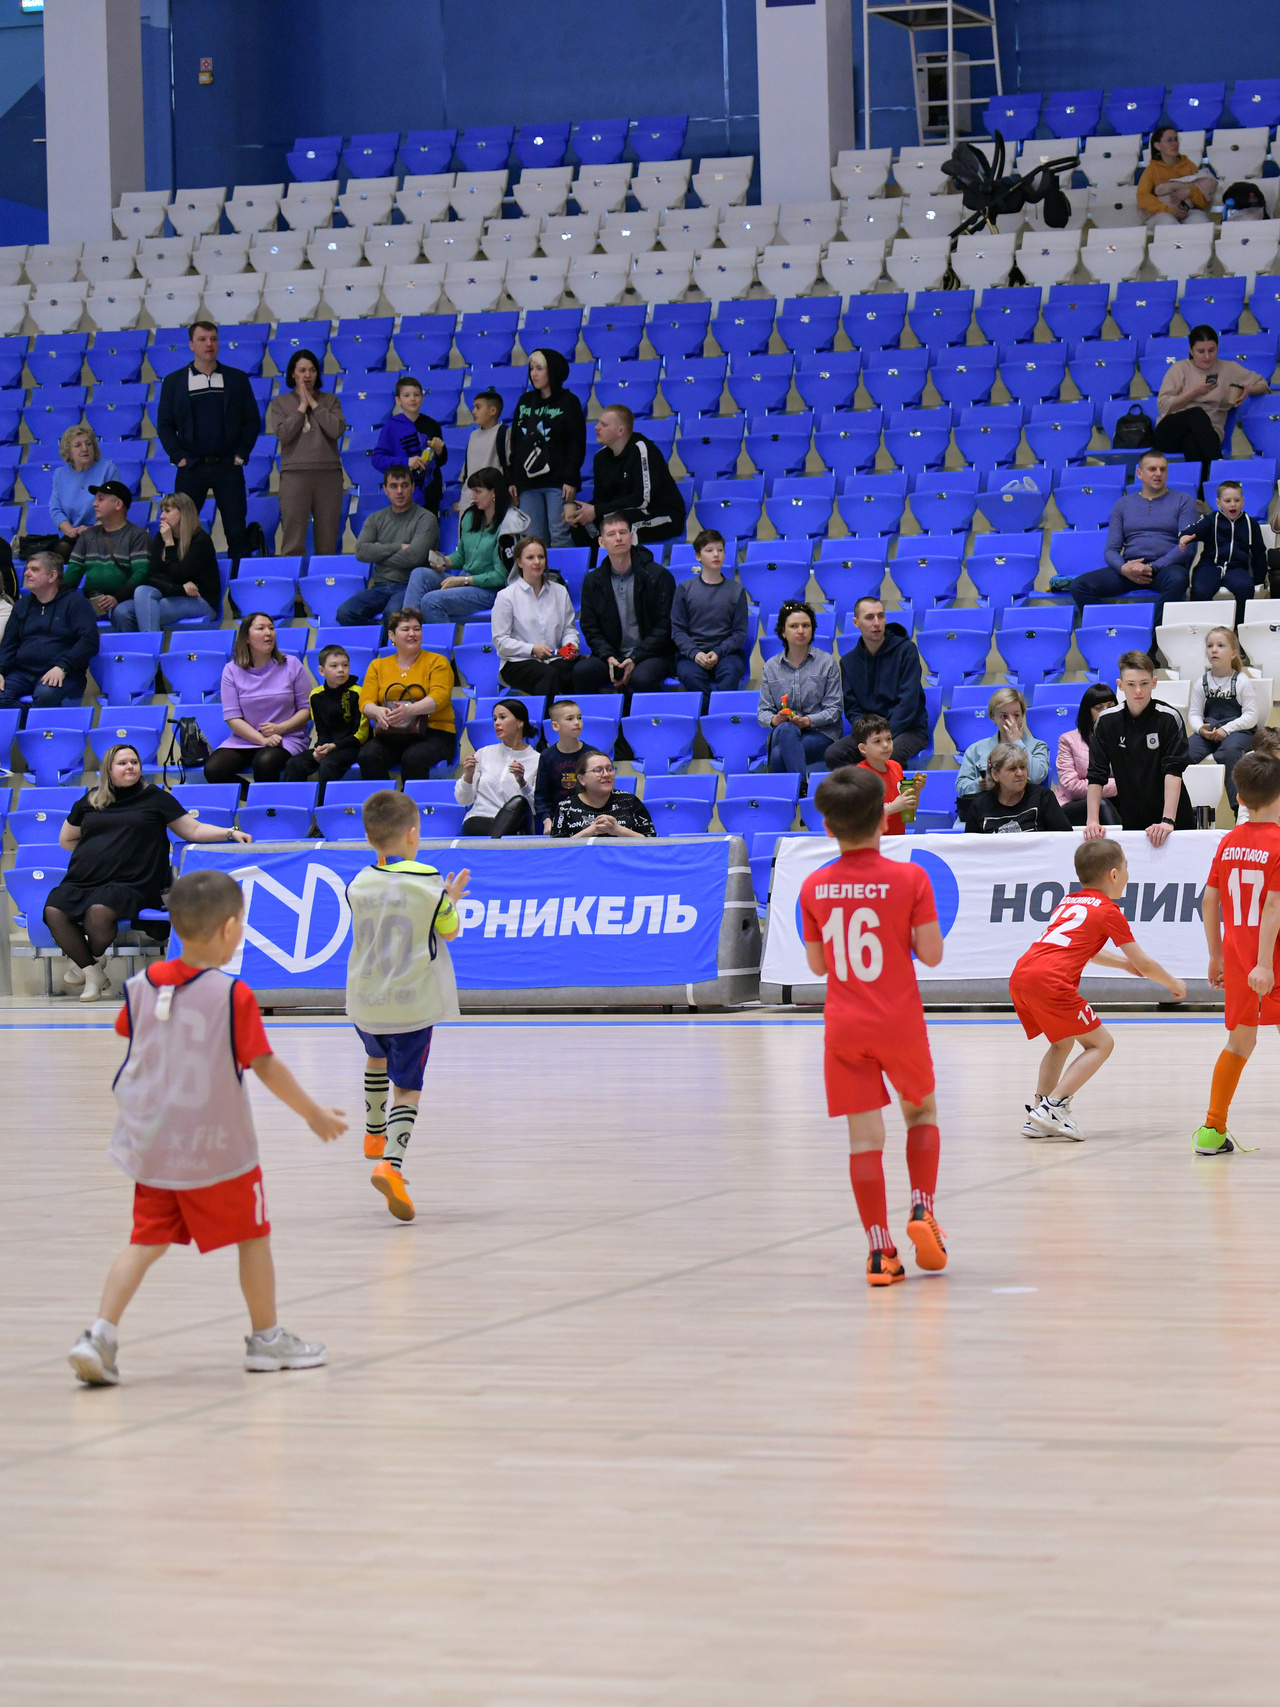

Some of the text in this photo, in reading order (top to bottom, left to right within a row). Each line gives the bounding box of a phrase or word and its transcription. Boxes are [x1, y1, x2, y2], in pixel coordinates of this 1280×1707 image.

[815, 883, 890, 900] ШЕЛЕСТ
[989, 881, 1224, 922] НОНИК
[1227, 867, 1264, 926] 17
[455, 894, 698, 938] РНИКЕЛЬ
[821, 907, 884, 982] 16
[1077, 1004, 1098, 1026] 12
